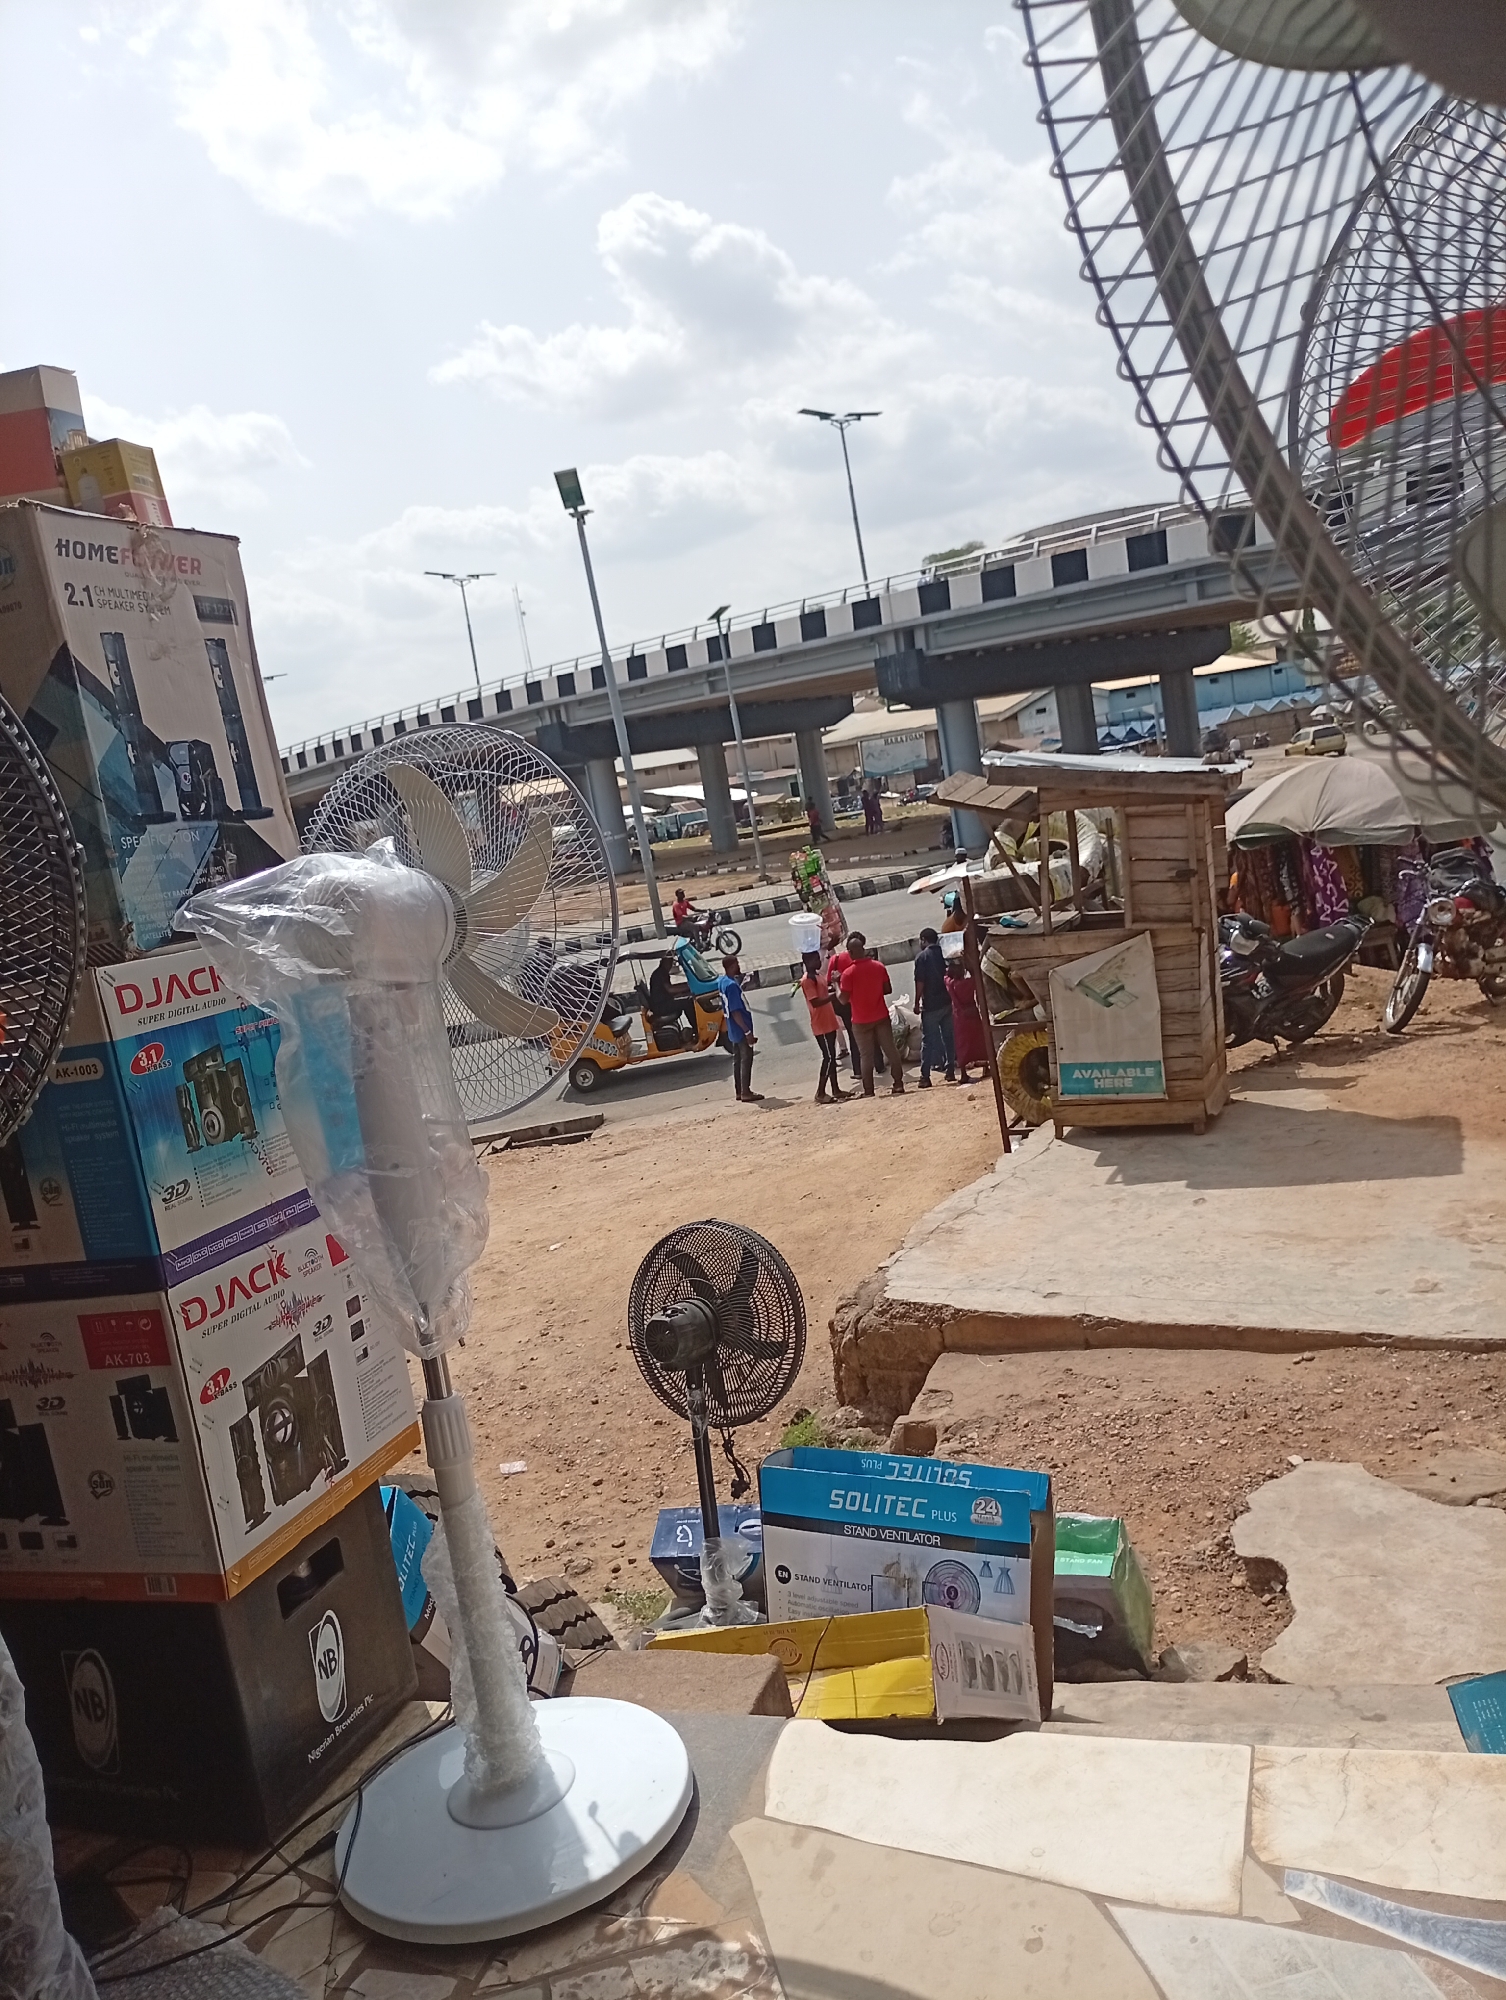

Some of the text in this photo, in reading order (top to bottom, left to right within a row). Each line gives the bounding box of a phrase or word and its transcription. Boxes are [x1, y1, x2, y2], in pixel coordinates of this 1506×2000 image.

[64, 582, 94, 608] 2.1
[93, 585, 156, 601] CH MULTIMEDIA
[96, 599, 135, 612] SPEAKER
[120, 831, 200, 849] SPECIFICATION
[137, 997, 227, 1027] SUPER DIGITAL AUDIO
[138, 1049, 158, 1066] 3.1
[55, 1064, 99, 1079] AK-1003
[1072, 1067, 1155, 1079] AVAILABLE
[1094, 1077, 1133, 1089] HERE
[161, 1178, 191, 1204] 3D
[180, 1252, 291, 1331] DJACK
[202, 1289, 285, 1339] SUPER DIGITAL AUDIO
[312, 1314, 333, 1337] 3D
[105, 1352, 152, 1366] AK-703
[206, 1374, 225, 1396] 3.1
[36, 1396, 66, 1411] 3D
[861, 1458, 883, 1470] PLUS
[829, 1489, 957, 1523] SOLITEC PLUS
[975, 1499, 998, 1516] 24
[844, 1524, 941, 1546] STAND VENTILATOR
[777, 1570, 788, 1579] EN
[794, 1573, 873, 1592] STAND VENTILATOR
[317, 1648, 338, 1680] NB
[73, 1688, 106, 1723] NB
[307, 1733, 335, 1764] Nigerian
[334, 1703, 365, 1737] Breweries
